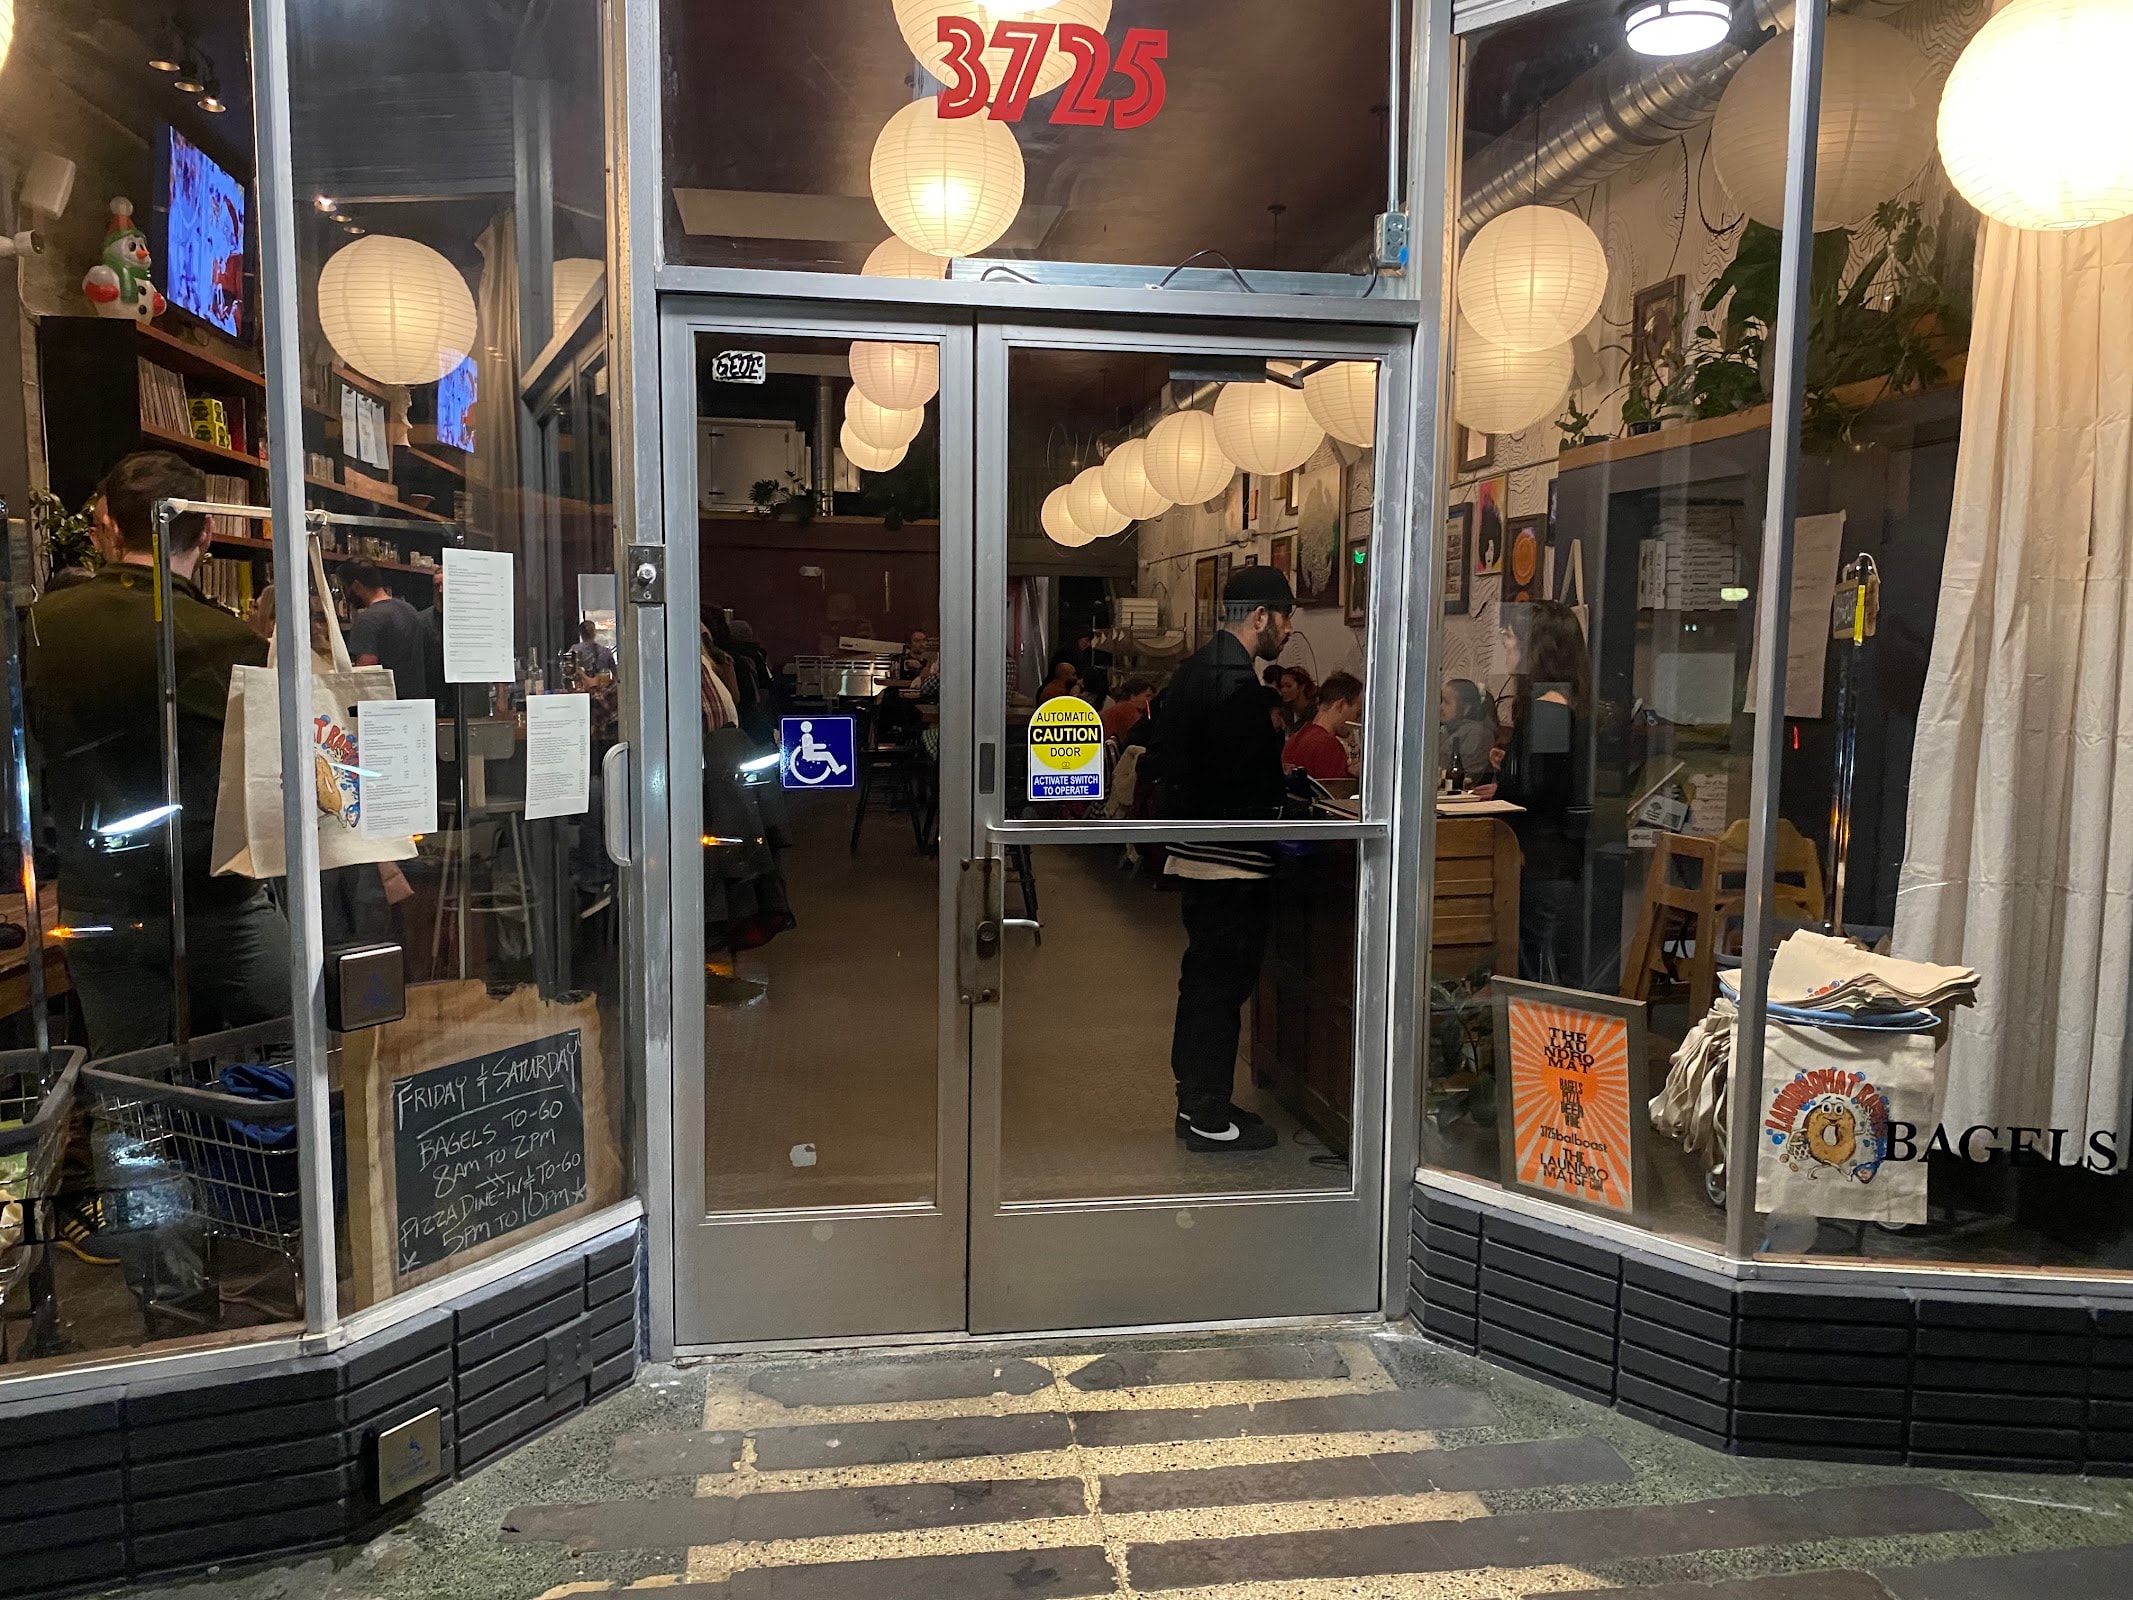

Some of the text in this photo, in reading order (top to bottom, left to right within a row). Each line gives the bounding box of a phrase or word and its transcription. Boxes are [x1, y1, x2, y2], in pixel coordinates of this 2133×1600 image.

[937, 15, 1168, 130] 3725
[1036, 711, 1095, 722] AUTOMATIC
[1032, 727, 1098, 742] CAUTION
[1050, 747, 1081, 757] DOOR
[1034, 775, 1098, 786] ACTIVATE SWITCH
[1043, 785, 1089, 795] TO OPERATE
[1549, 1027, 1587, 1043] THE
[1550, 1037, 1587, 1053] LAU
[1544, 1046, 1595, 1066] NDRO
[1548, 1057, 1591, 1074] MAT
[397, 1075, 467, 1131] FRIDAY
[491, 1040, 578, 1093] SATURDAY
[1559, 1077, 1583, 1095] BAGELS
[1765, 1069, 1861, 1133] LAUNDROMAT
[417, 1100, 563, 1172] BAGELS TO-GO
[432, 1128, 556, 1198] 8AM TO 2PM
[1562, 1147, 1585, 1165] THE
[1540, 1153, 1609, 1181] LAUNDRO
[400, 1203, 461, 1248] PIZZA
[459, 1178, 522, 1222] DINE-IN
[536, 1153, 581, 1184] TO-GO
[442, 1187, 569, 1256] 5PM TO 10PM
